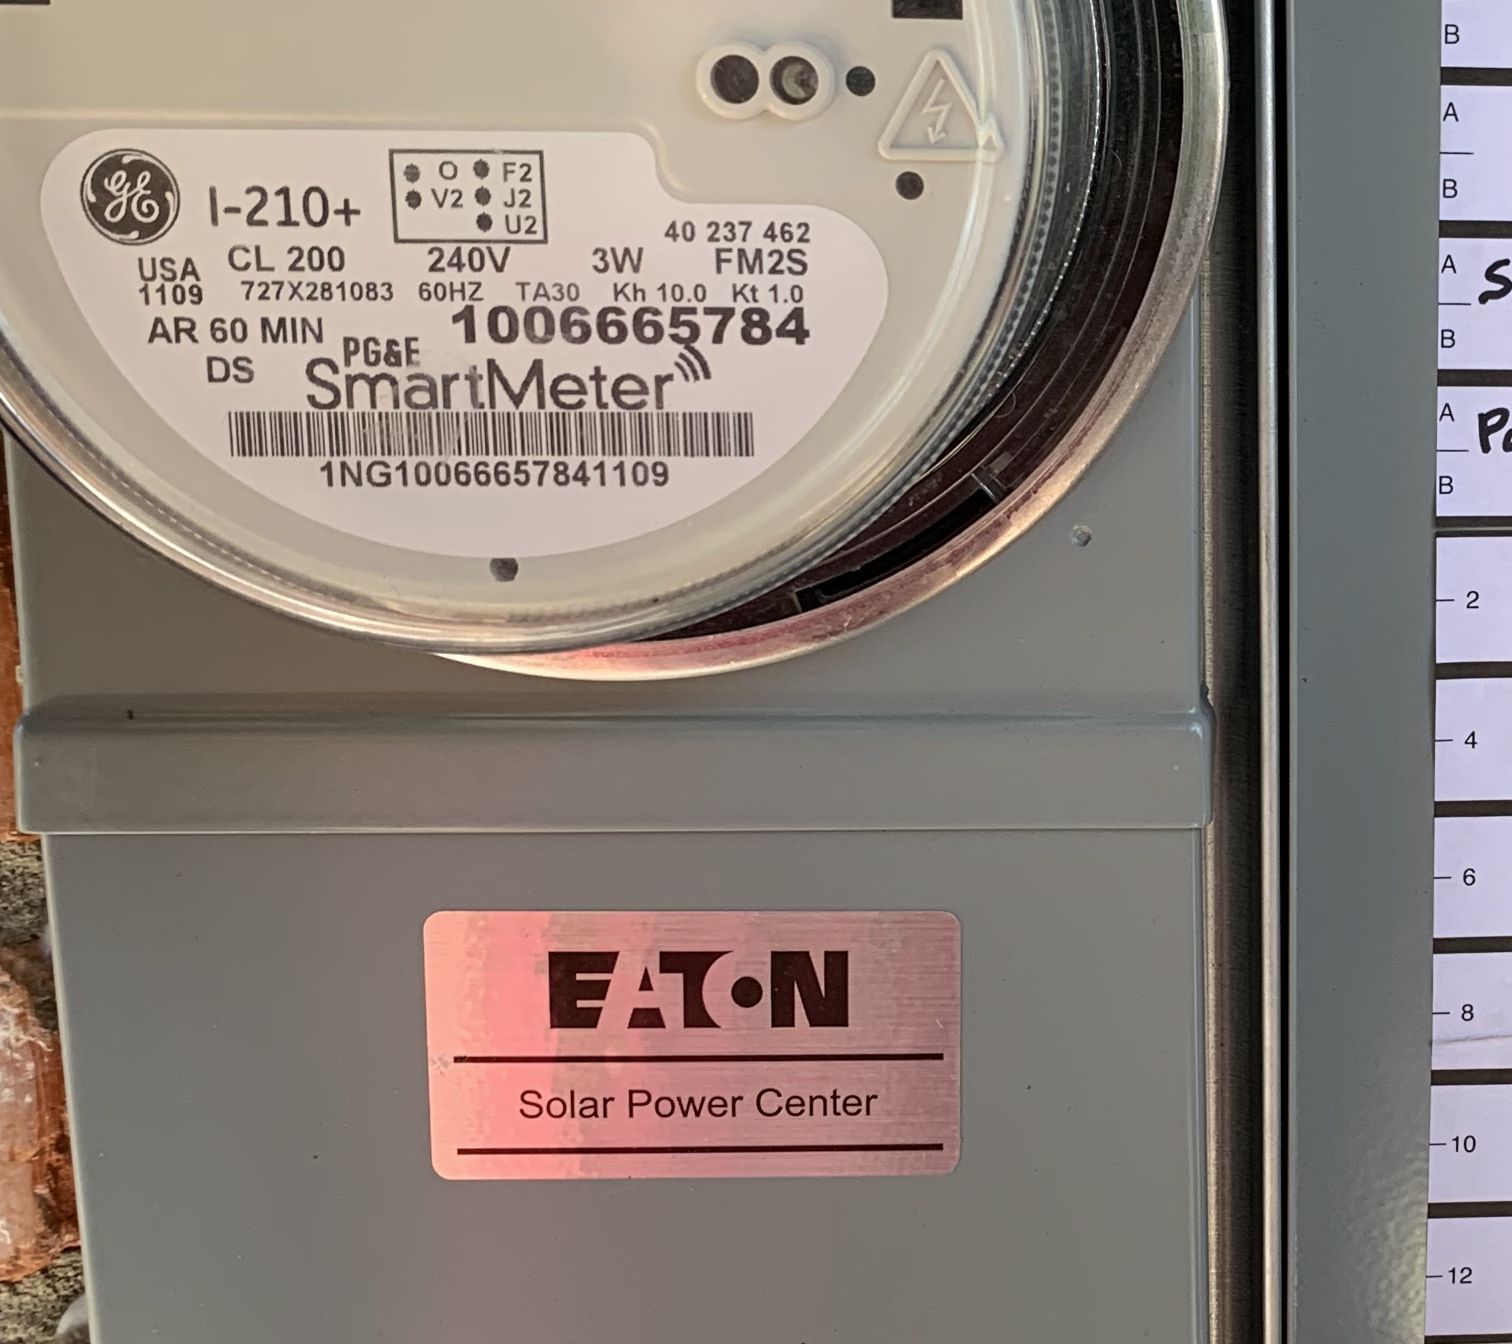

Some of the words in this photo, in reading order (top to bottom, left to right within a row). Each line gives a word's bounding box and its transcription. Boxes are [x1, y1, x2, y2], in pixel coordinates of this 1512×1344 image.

[1444, 24, 1460, 44] B
[503, 163, 532, 182] F2
[209, 185, 361, 228] I-210+
[431, 189, 463, 208] V2
[504, 189, 532, 209] J2
[505, 215, 537, 235] U2
[665, 221, 695, 242] 40
[706, 222, 752, 242] 237
[763, 222, 810, 243] 462
[138, 257, 201, 282] USA
[228, 245, 275, 272] CL
[287, 245, 345, 272] 200
[427, 247, 510, 273] 240V
[592, 247, 644, 274] 3W
[715, 248, 808, 275] FM2S
[1441, 255, 1457, 274] A
[138, 284, 203, 306] 1109
[241, 281, 394, 302] 727X281083
[418, 282, 484, 302] 60HZ
[516, 282, 580, 302] TA30
[614, 283, 646, 302] Kh
[657, 283, 707, 303] 10.0
[732, 284, 759, 303] Kt
[769, 284, 803, 303] 1.0
[148, 317, 199, 344] AR
[209, 317, 248, 344] 60
[260, 317, 323, 344] MIN
[452, 305, 810, 345] 1006665784
[1441, 329, 1455, 348] B
[343, 337, 419, 367] PG&E
[207, 356, 255, 384] DS
[305, 357, 675, 411] SmartMeter
[320, 460, 669, 487] 1NG10066657841109
[1466, 591, 1479, 609] 2
[1464, 731, 1477, 749] 4
[1463, 868, 1476, 886] 6
[548, 950, 849, 1029] EATON
[1461, 1004, 1474, 1021] 8
[519, 1090, 615, 1119] Solar
[628, 1090, 743, 1118] Power
[755, 1088, 878, 1117] Center
[1451, 1135, 1476, 1153] 10
[1448, 1267, 1473, 1284] 12
